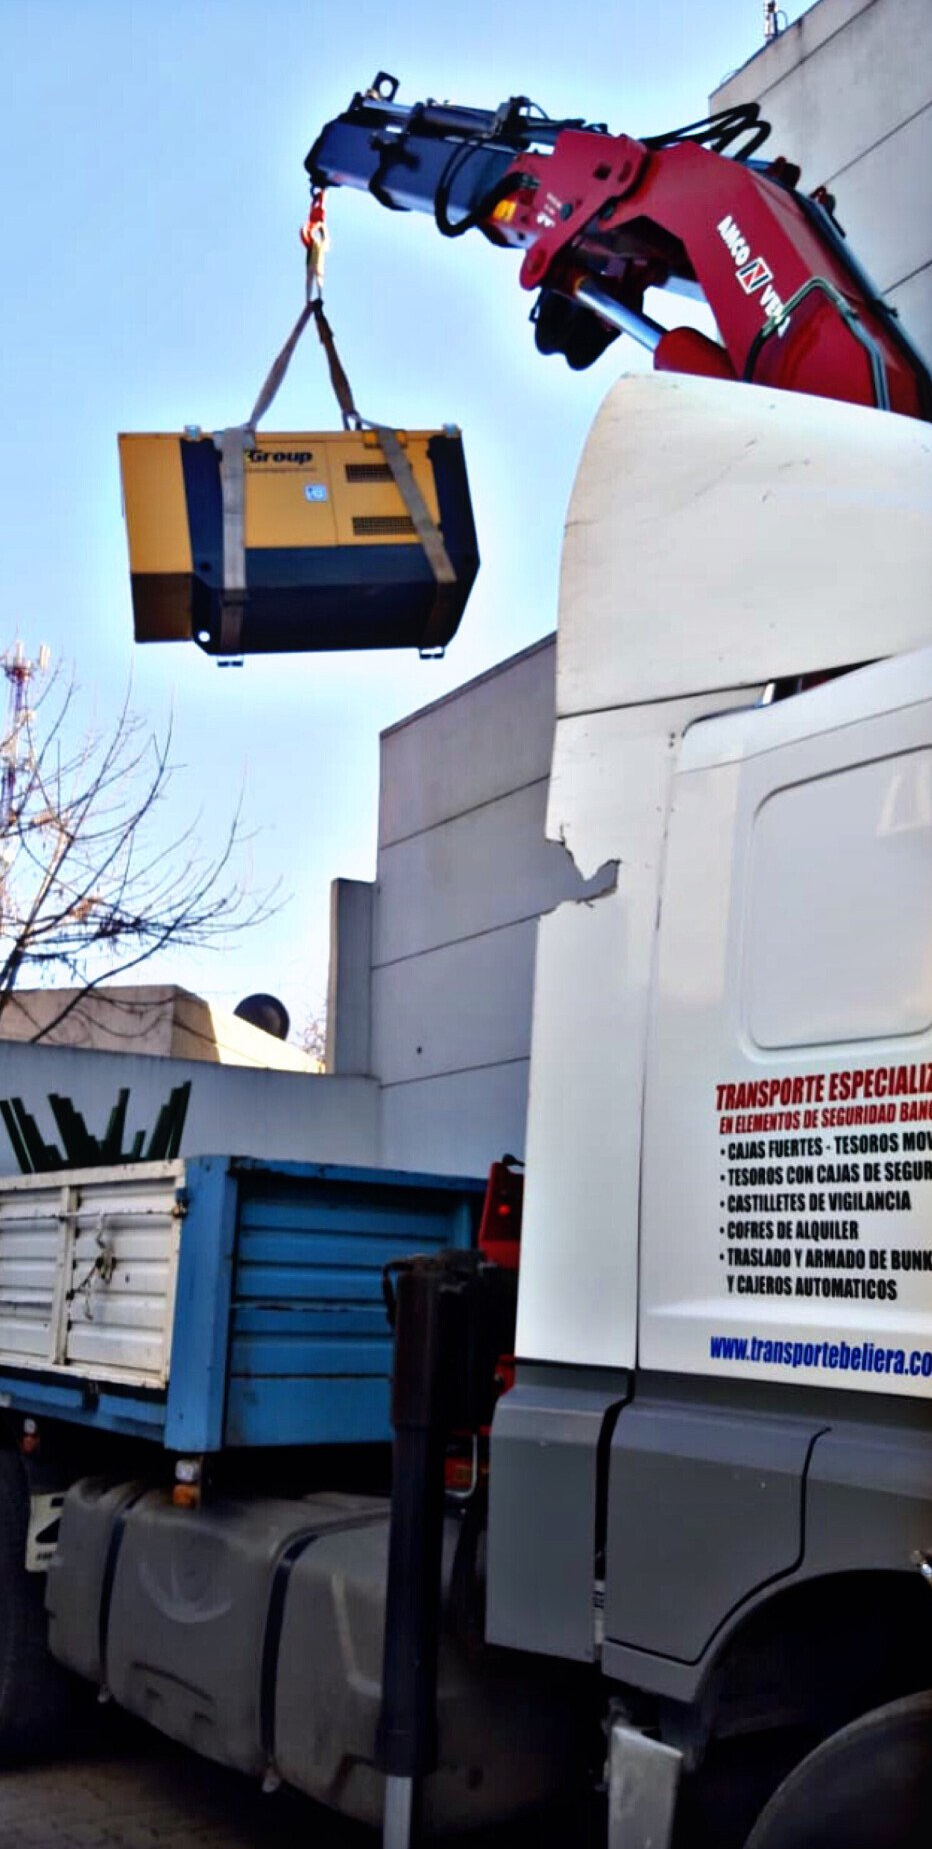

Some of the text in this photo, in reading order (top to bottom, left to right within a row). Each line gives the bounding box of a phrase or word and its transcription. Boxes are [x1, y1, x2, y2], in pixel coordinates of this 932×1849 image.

[717, 215, 751, 267] AMCO
[716, 1074, 825, 1111] TRANSPORTE
[719, 1116, 733, 1135] EN
[735, 1110, 800, 1134] ELEMENTOS
[803, 1109, 818, 1130] DE
[821, 1103, 896, 1127] SEGURIDAD
[728, 1141, 766, 1161] CAJAS
[768, 1137, 823, 1158] FUERTES
[833, 1133, 899, 1155] TESOROS
[728, 1160, 932, 1187] TESOROS CON CAJAS DE SEGUR
[727, 1191, 912, 1213] CASTILLETES DE VIGILANCIA
[727, 1220, 859, 1242] COFRES DE ALQUILER
[727, 1248, 932, 1271] TRASLADO Y ARMADO DE BUNK
[727, 1275, 898, 1300] Y CAJEROS AUTOMATICOS
[710, 1336, 932, 1377] www.transportebeliera.co
